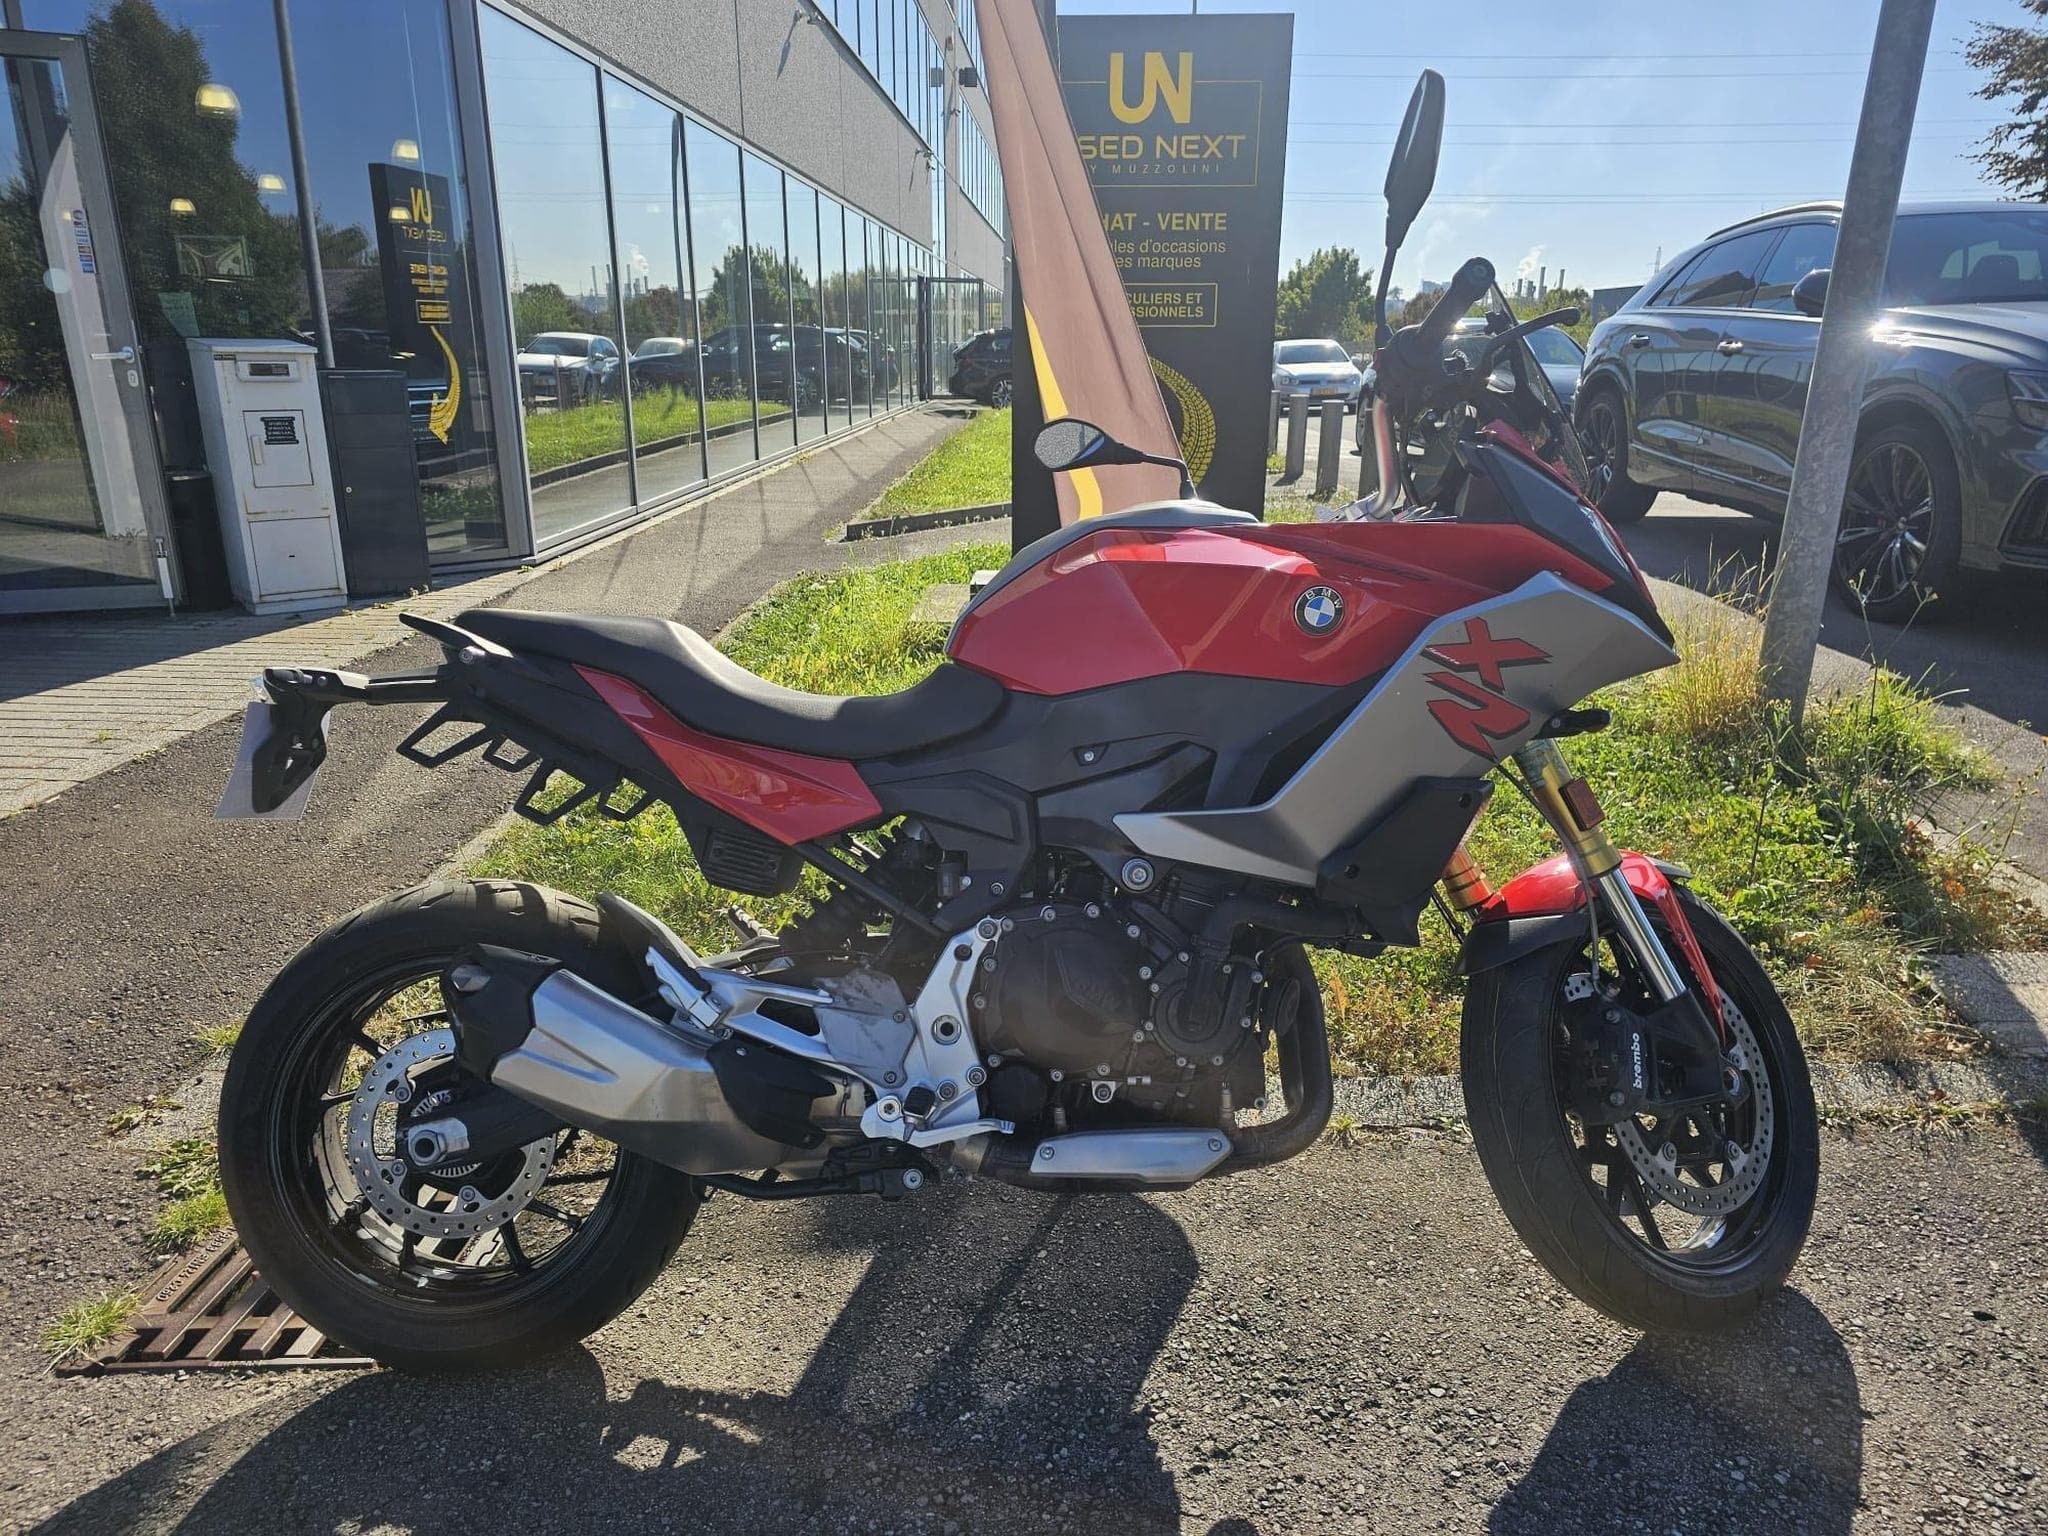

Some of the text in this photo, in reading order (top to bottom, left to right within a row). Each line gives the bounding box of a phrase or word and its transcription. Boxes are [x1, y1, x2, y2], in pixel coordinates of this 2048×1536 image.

[1109, 52, 1193, 124] UN
[1078, 134, 1247, 160] SED NEXT
[1112, 164, 1219, 174] MUZZOLINI
[1157, 212, 1228, 231] VENTE
[1139, 239, 1227, 253] d'occasions
[1138, 257, 1202, 270] marques
[1186, 293, 1203, 304] ET
[1305, 587, 1343, 609] BMW
[1631, 1032, 1642, 1089] brembo
